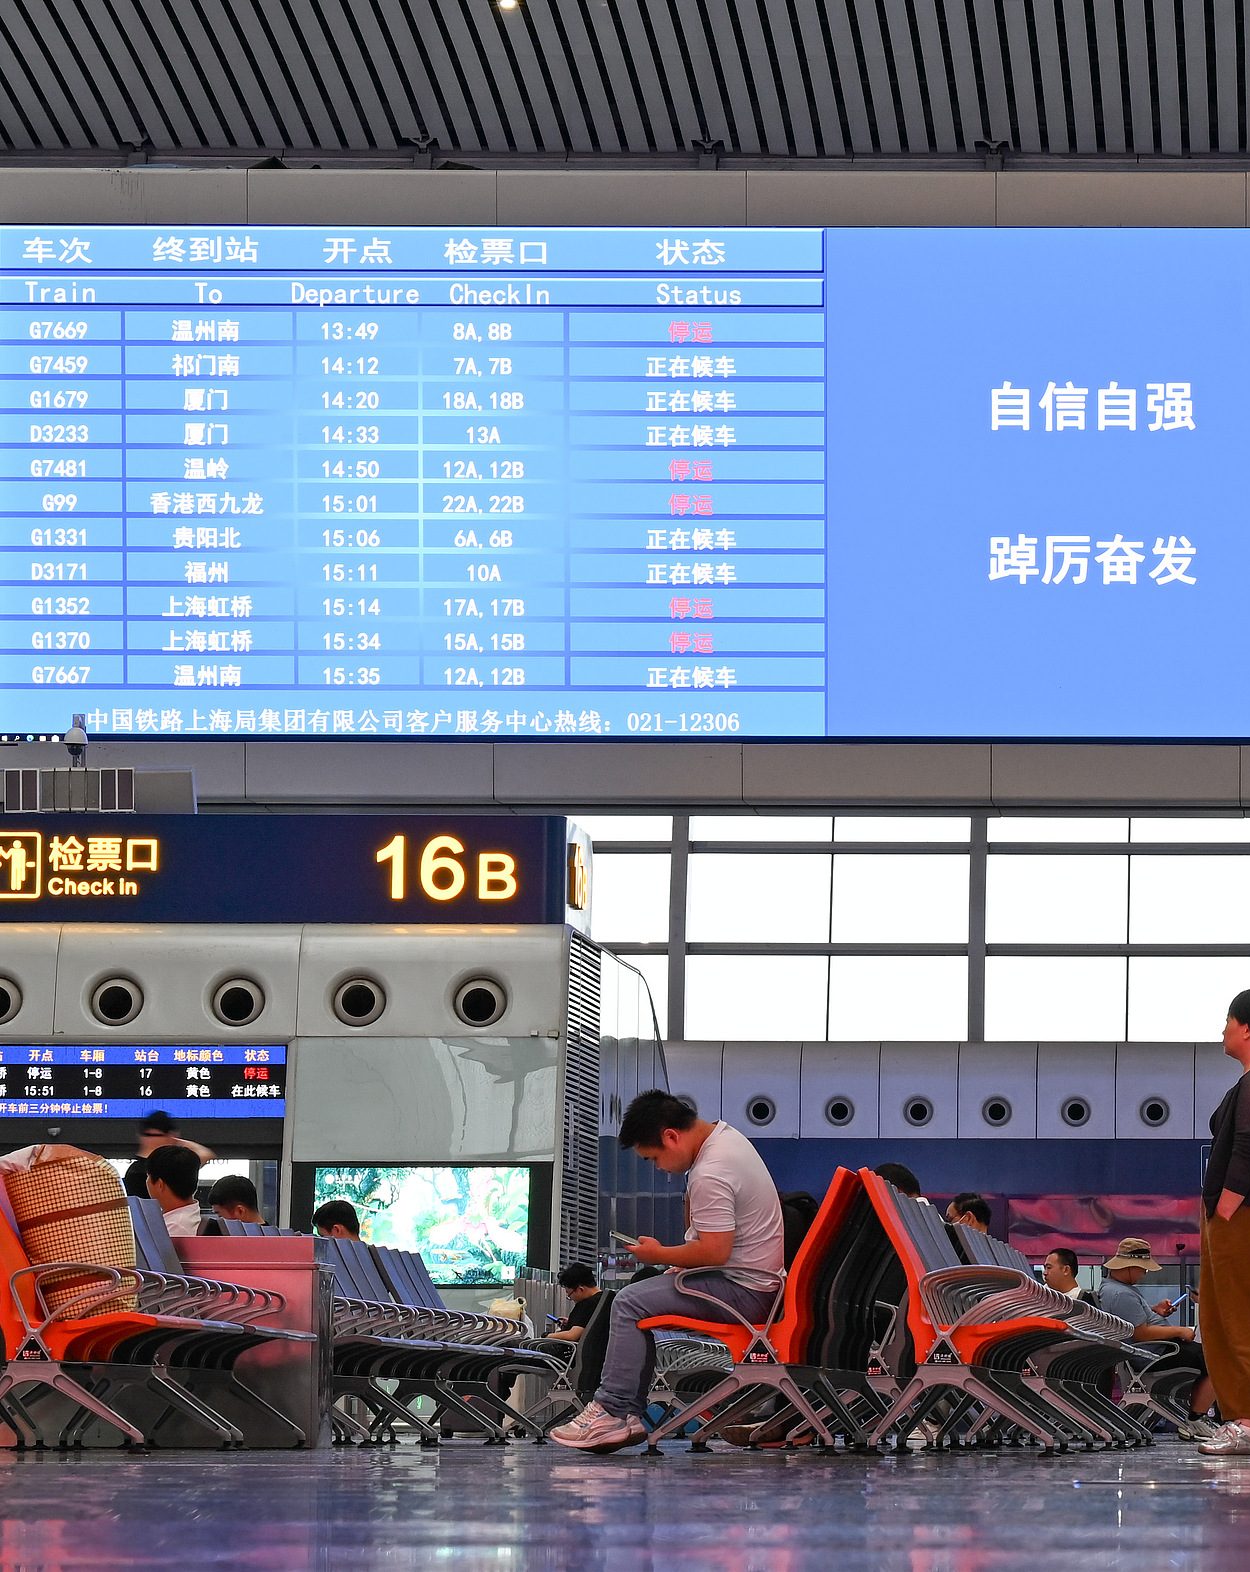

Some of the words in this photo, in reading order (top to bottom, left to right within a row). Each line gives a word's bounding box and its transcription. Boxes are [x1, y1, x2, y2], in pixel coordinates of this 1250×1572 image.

[22, 236, 93, 264] 车次
[152, 235, 259, 263] 终到站
[322, 237, 393, 264] 开点
[443, 238, 547, 265] 检票口
[655, 238, 726, 266] 状态
[24, 282, 96, 303] Train
[194, 282, 223, 304] To
[291, 282, 420, 307] Departure
[656, 283, 742, 305] Status
[29, 321, 88, 340] G7669
[171, 319, 240, 342] 温州南
[321, 322, 379, 340] 13:49
[667, 320, 714, 344] 停运
[29, 355, 88, 374] G7459
[171, 353, 240, 377] 祁门南
[321, 356, 379, 375] 14:12
[645, 355, 737, 378] 正在候车
[29, 390, 89, 409] G1679
[183, 388, 228, 411] 厦门
[991, 380, 1196, 432] 自信自强
[30, 424, 89, 443] D3233
[183, 422, 228, 446] 厦门
[321, 425, 379, 444] 14:33
[30, 459, 86, 478] G7481
[183, 457, 230, 480] 温岭
[322, 460, 381, 479] 14:50
[42, 493, 78, 512] G99
[150, 491, 264, 515] 香港西九龙
[322, 494, 377, 513] 15:01
[30, 528, 87, 546] G1331
[172, 526, 242, 549] 贵阳北
[988, 533, 1197, 586] 踔厉奋发
[31, 562, 87, 581] D3171
[184, 560, 229, 584] 福州
[322, 563, 377, 582] 15:11
[31, 597, 90, 615] G1352
[161, 595, 253, 618] 上海虹桥
[322, 598, 381, 616] 15:14
[31, 631, 91, 650] G1370
[161, 629, 253, 653] 上海虹桥
[323, 632, 381, 651] 15:34
[32, 666, 91, 684] G7667
[173, 663, 242, 687] 温州南
[48, 835, 158, 872] 检票口
[376, 835, 517, 901] 16B
[47, 877, 115, 896] Check
[119, 877, 138, 896] in
[28, 1049, 54, 1062] 开点
[80, 1049, 105, 1062] 车厢
[134, 1049, 160, 1062] 站台
[173, 1049, 224, 1062] 地标颜色
[244, 1049, 270, 1062] 状态
[26, 1066, 53, 1080] 停运
[83, 1067, 103, 1079] 1-8
[139, 1068, 153, 1079] 17
[185, 1066, 211, 1080] 黄色
[243, 1066, 270, 1080] 停运
[24, 1085, 54, 1097] 15:51
[83, 1085, 103, 1097] 1-8
[139, 1085, 153, 1097] 16
[185, 1084, 211, 1098] 黄色
[230, 1084, 282, 1098] 在此候车
